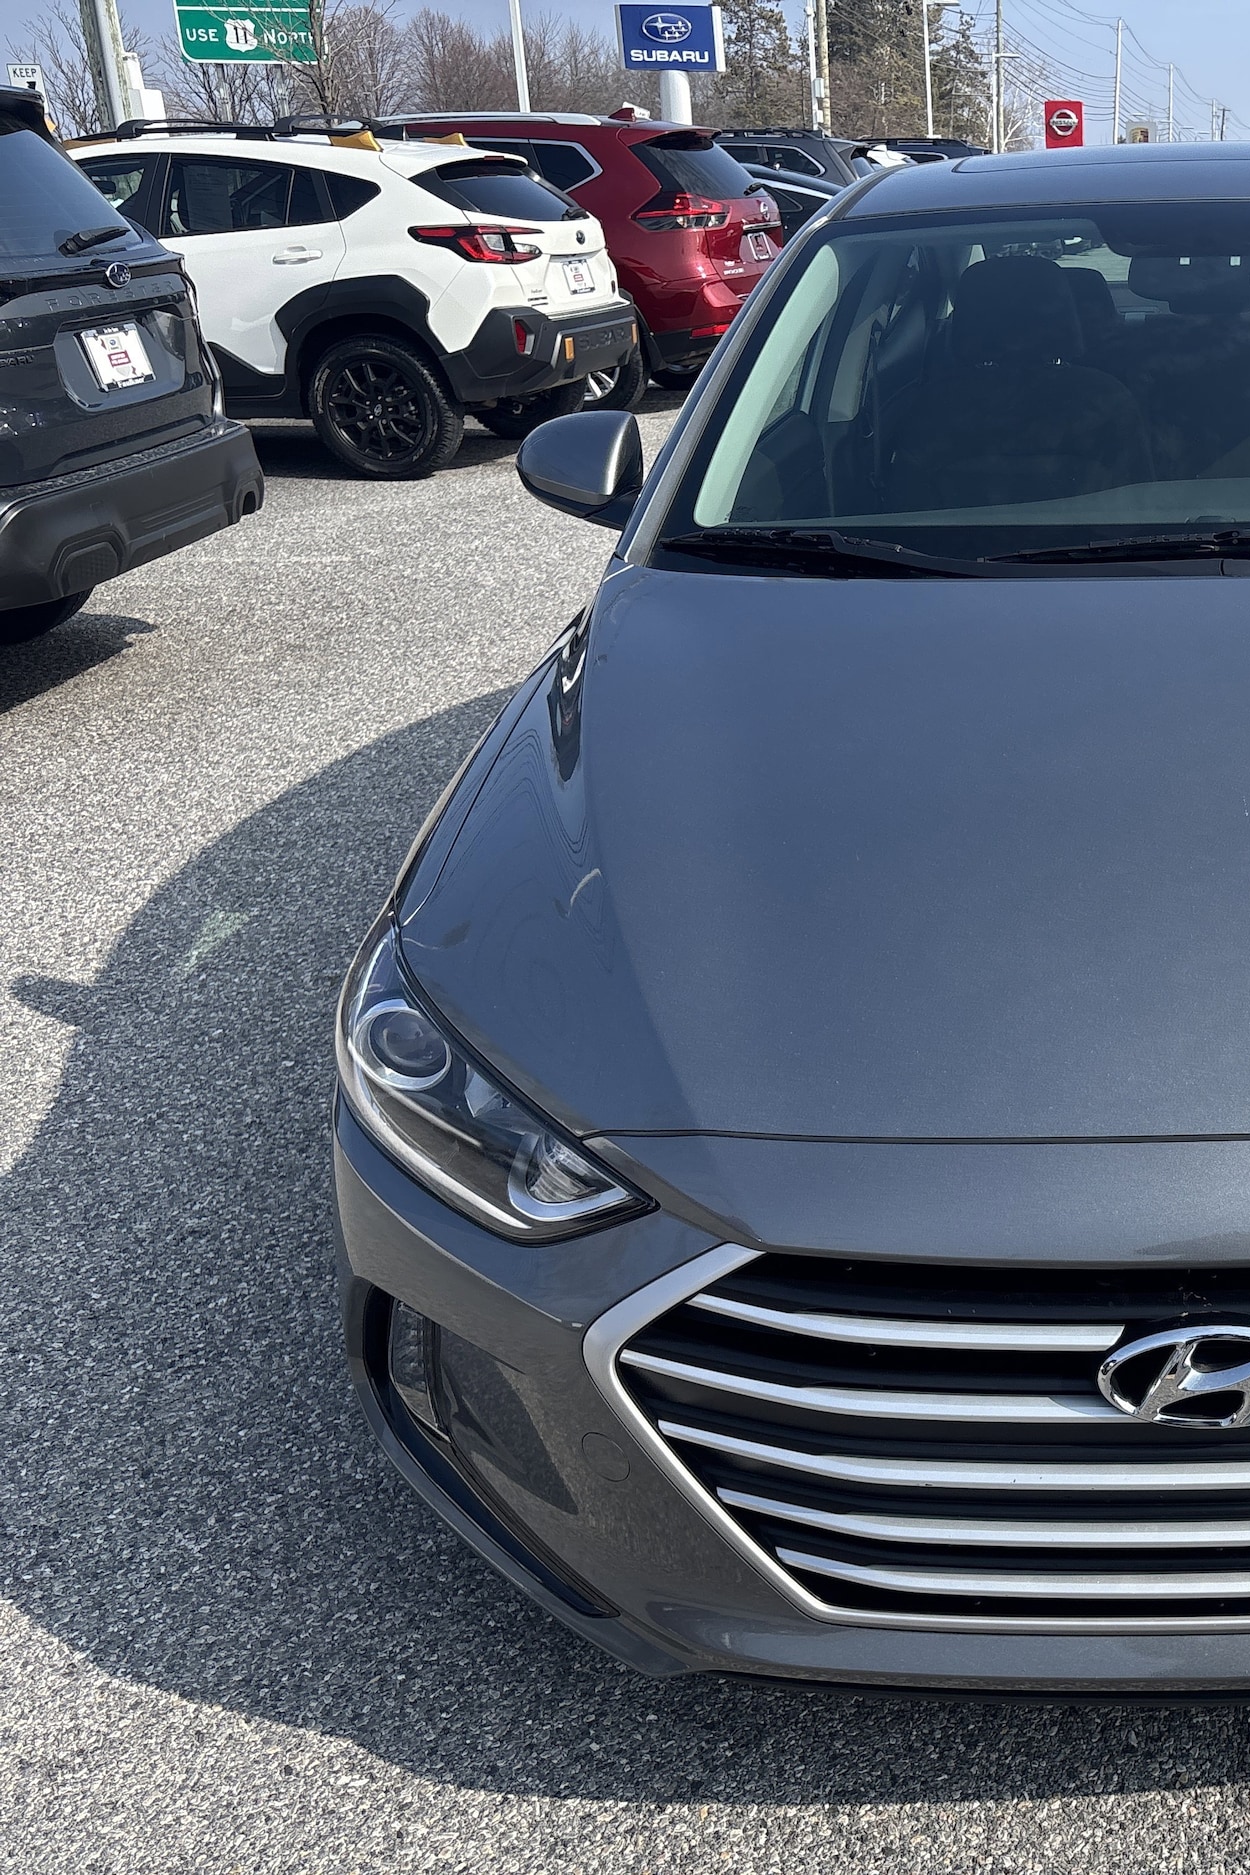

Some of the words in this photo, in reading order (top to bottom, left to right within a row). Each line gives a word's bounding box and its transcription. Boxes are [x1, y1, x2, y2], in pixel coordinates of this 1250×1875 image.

[185, 28, 219, 42] USE
[233, 26, 248, 44] 11
[630, 49, 709, 63] SUBARU
[12, 67, 37, 78] KEEP
